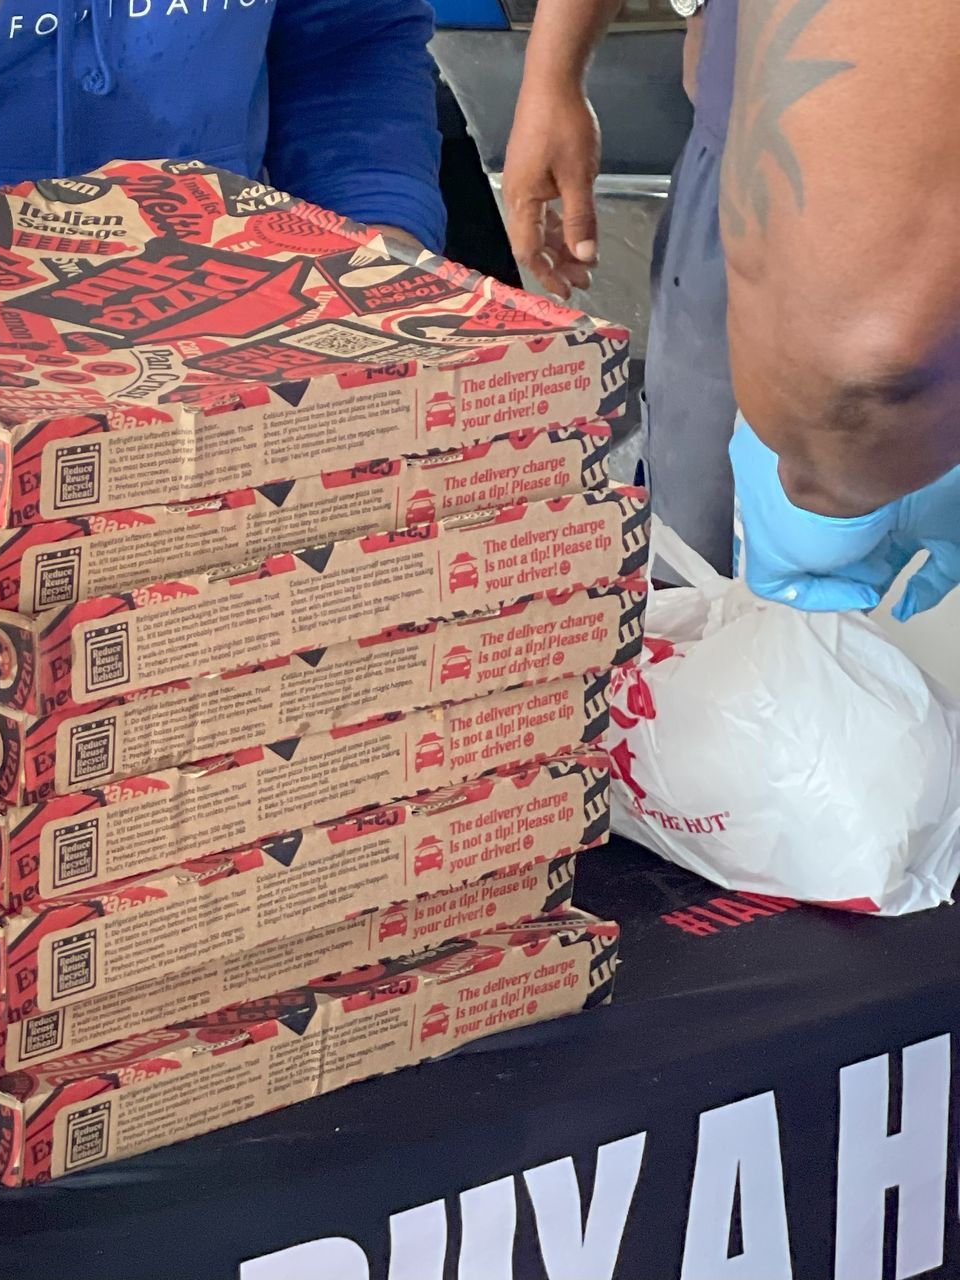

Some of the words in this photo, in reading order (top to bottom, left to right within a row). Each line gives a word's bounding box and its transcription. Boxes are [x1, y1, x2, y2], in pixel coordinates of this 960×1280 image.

[17, 216, 127, 241] Sausage
[18, 200, 124, 227] Italian
[51, 254, 195, 306] Hut
[90, 258, 272, 331] Pizza
[463, 379, 489, 394] The
[490, 369, 539, 389] delivery
[542, 360, 585, 380] charge
[475, 395, 495, 410] not
[498, 395, 505, 404] a
[509, 388, 529, 402] tip!
[532, 380, 571, 397] Please
[575, 375, 591, 390] tip
[462, 413, 491, 431] your
[494, 402, 535, 422] driver!
[63, 465, 93, 477] Reduce
[66, 474, 90, 484] Reuse
[445, 476, 466, 491] The
[470, 465, 519, 482] delivery
[523, 456, 566, 475] charge
[62, 482, 93, 492] Recycle
[62, 489, 93, 500] Reheat!
[456, 490, 475, 506] not
[478, 491, 485, 501] a
[489, 483, 509, 498] tip!
[512, 475, 551, 494] Please
[554, 471, 570, 486] tip
[483, 539, 508, 554] The
[511, 529, 558, 551] delivery
[562, 520, 605, 536] charge
[498, 555, 517, 571] not
[520, 555, 528, 565] a
[531, 548, 550, 563] tip!
[553, 539, 593, 557] Please
[596, 534, 611, 550] tip
[485, 575, 513, 593] your
[517, 563, 558, 584] driver!
[481, 633, 503, 647] The
[507, 621, 556, 641] delivery
[560, 612, 604, 630] charge
[492, 646, 512, 661] not
[515, 646, 522, 656] a
[526, 638, 546, 654] tip!
[549, 631, 588, 649] Please
[592, 627, 608, 643] tip
[92, 645, 122, 658] Reduce
[95, 655, 119, 666] Reuse
[92, 662, 122, 675] Recycle
[92, 668, 122, 684] Reheat!
[476, 665, 505, 683] your
[508, 654, 550, 674] driver!
[458, 989, 480, 1004] The
[484, 973, 532, 995] delivery
[534, 959, 576, 979] charge
[469, 1001, 488, 1016] not
[491, 1000, 498, 1009] a
[501, 991, 520, 1007] tip!
[523, 981, 560, 999] Please
[563, 974, 579, 991] tip
[454, 1020, 482, 1038] your
[485, 1005, 525, 1026] driver!
